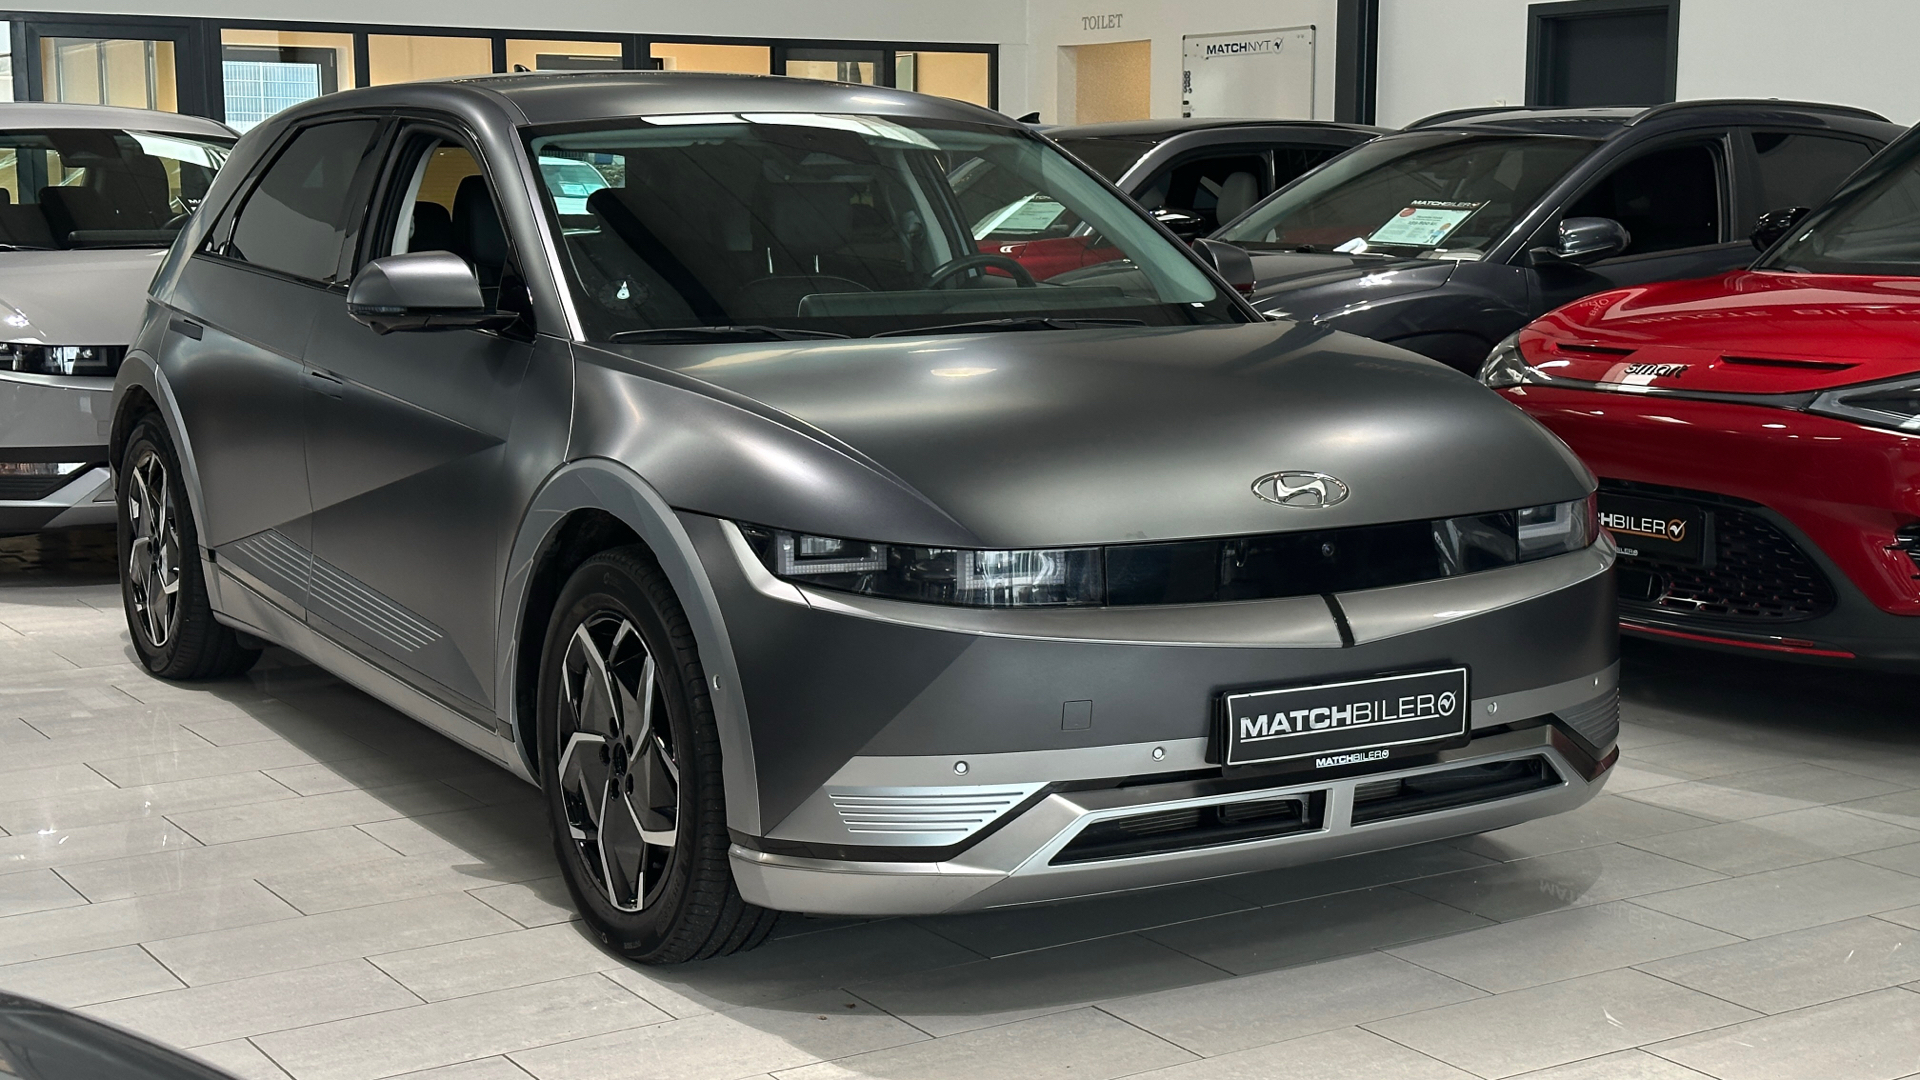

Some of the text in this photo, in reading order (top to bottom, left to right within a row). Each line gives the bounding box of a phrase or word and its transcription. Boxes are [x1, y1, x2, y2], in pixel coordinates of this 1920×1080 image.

[1082, 14, 1124, 30] TOILET
[1206, 40, 1271, 55] MATCHNYT
[1411, 199, 1471, 207] MATCHBILER
[1624, 363, 1688, 378] smart
[1597, 512, 1666, 535] HBILER
[1240, 693, 1436, 739] MATCHBILER
[1316, 749, 1384, 768] MATCHBILER
